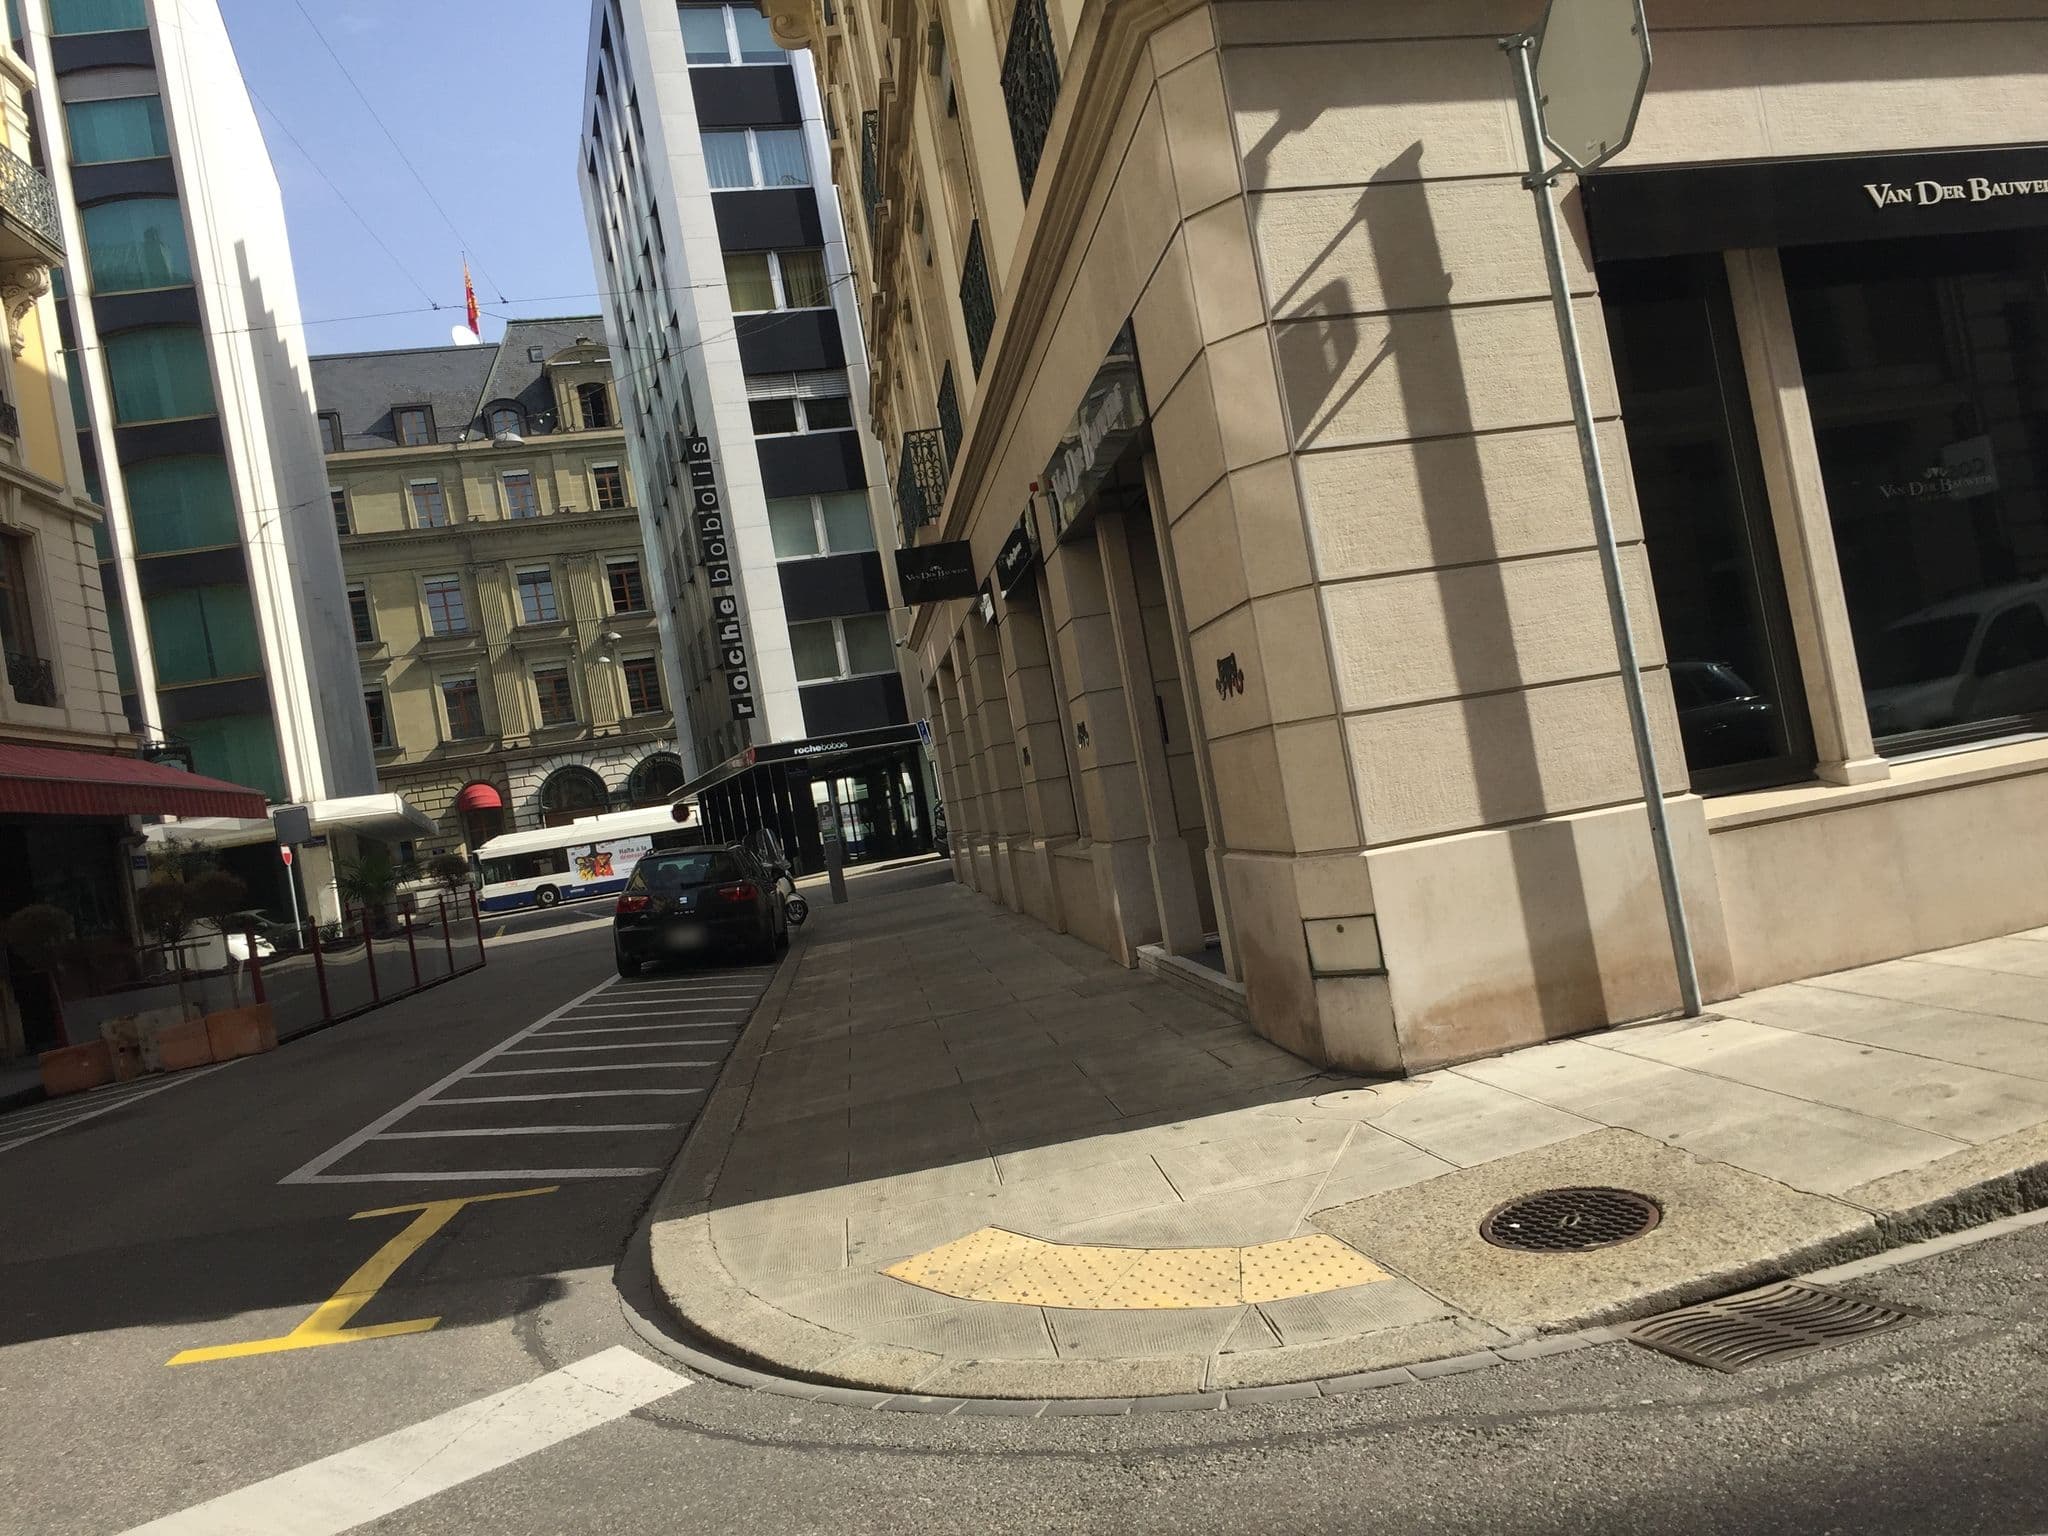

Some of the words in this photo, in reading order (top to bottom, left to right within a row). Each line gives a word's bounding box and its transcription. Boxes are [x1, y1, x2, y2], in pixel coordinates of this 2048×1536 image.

[1864, 183, 1912, 208] VAN
[1914, 180, 1966, 206] DER
[692, 441, 731, 582] bobois
[719, 598, 752, 714] roche
